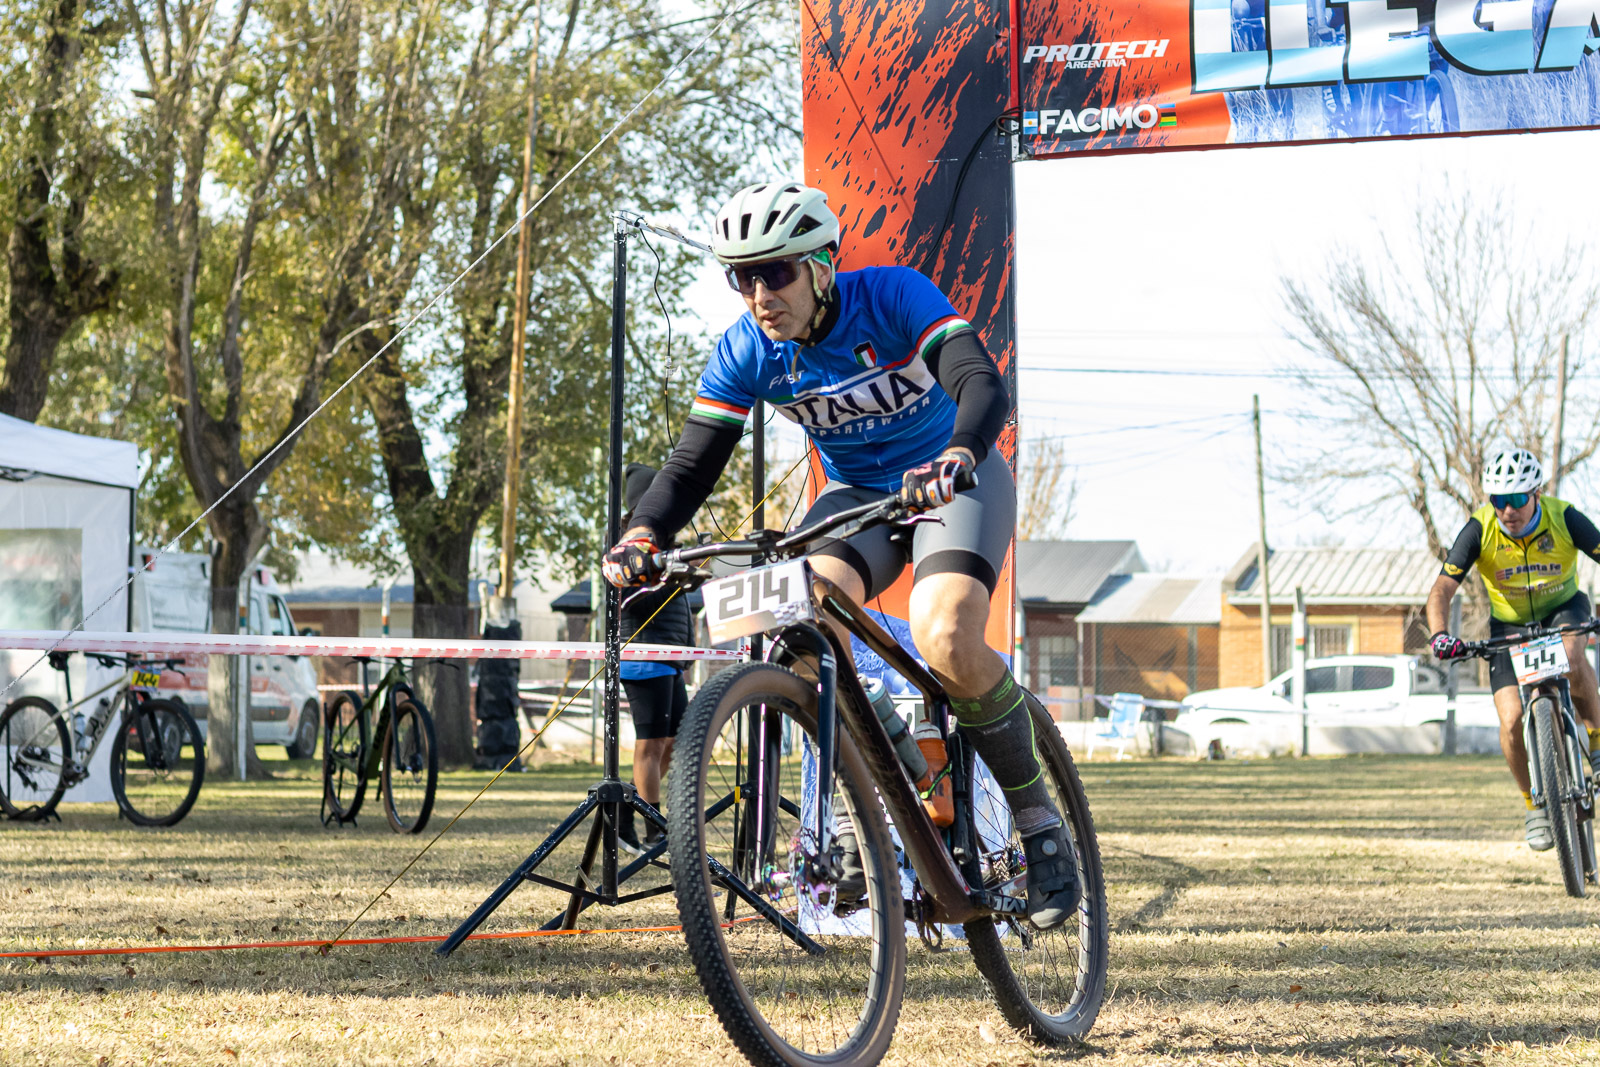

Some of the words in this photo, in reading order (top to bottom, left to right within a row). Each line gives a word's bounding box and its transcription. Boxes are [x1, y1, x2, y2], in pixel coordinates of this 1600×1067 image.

[1023, 39, 1170, 63] PROTECH
[1064, 58, 1127, 69] ARGENTINA
[1040, 104, 1159, 134] FACIMO
[783, 371, 927, 427] ITALIA
[1516, 563, 1548, 574] Santa
[719, 570, 789, 620] 214
[1524, 649, 1556, 671] 44
